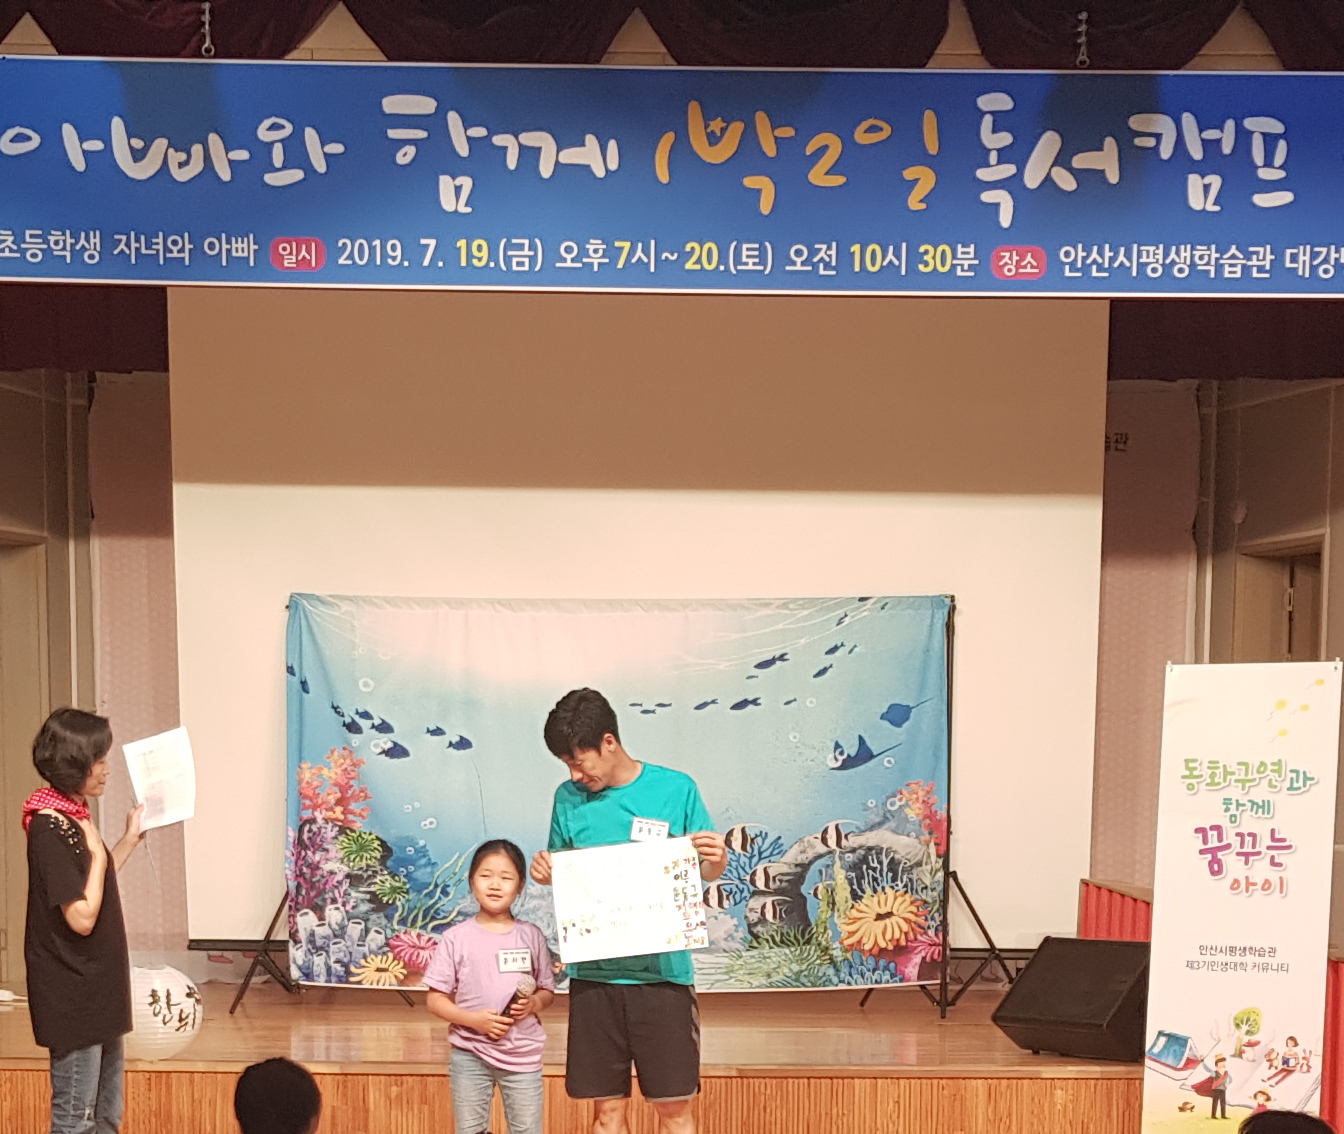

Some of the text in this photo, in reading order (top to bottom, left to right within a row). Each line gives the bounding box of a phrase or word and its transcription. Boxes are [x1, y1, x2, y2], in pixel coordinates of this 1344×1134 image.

[0, 115, 346, 187] 아빠와
[381, 94, 620, 213] 함께
[112, 232, 194, 266] 자녀와
[203, 233, 260, 268] 아빠
[278, 242, 318, 268] 일시
[337, 238, 410, 269] 2019.
[419, 238, 445, 269] 7.
[784, 242, 839, 277] 오전
[850, 242, 908, 277] 10시
[917, 243, 980, 278] 30분
[998, 250, 1040, 277] 장소
[1059, 243, 1276, 280] 안산시평생학습관
[1180, 758, 1316, 792] 동화구연과
[1222, 797, 1272, 825] 함께
[1194, 824, 1294, 877] 꿈꾸는
[1229, 875, 1285, 895] 아이
